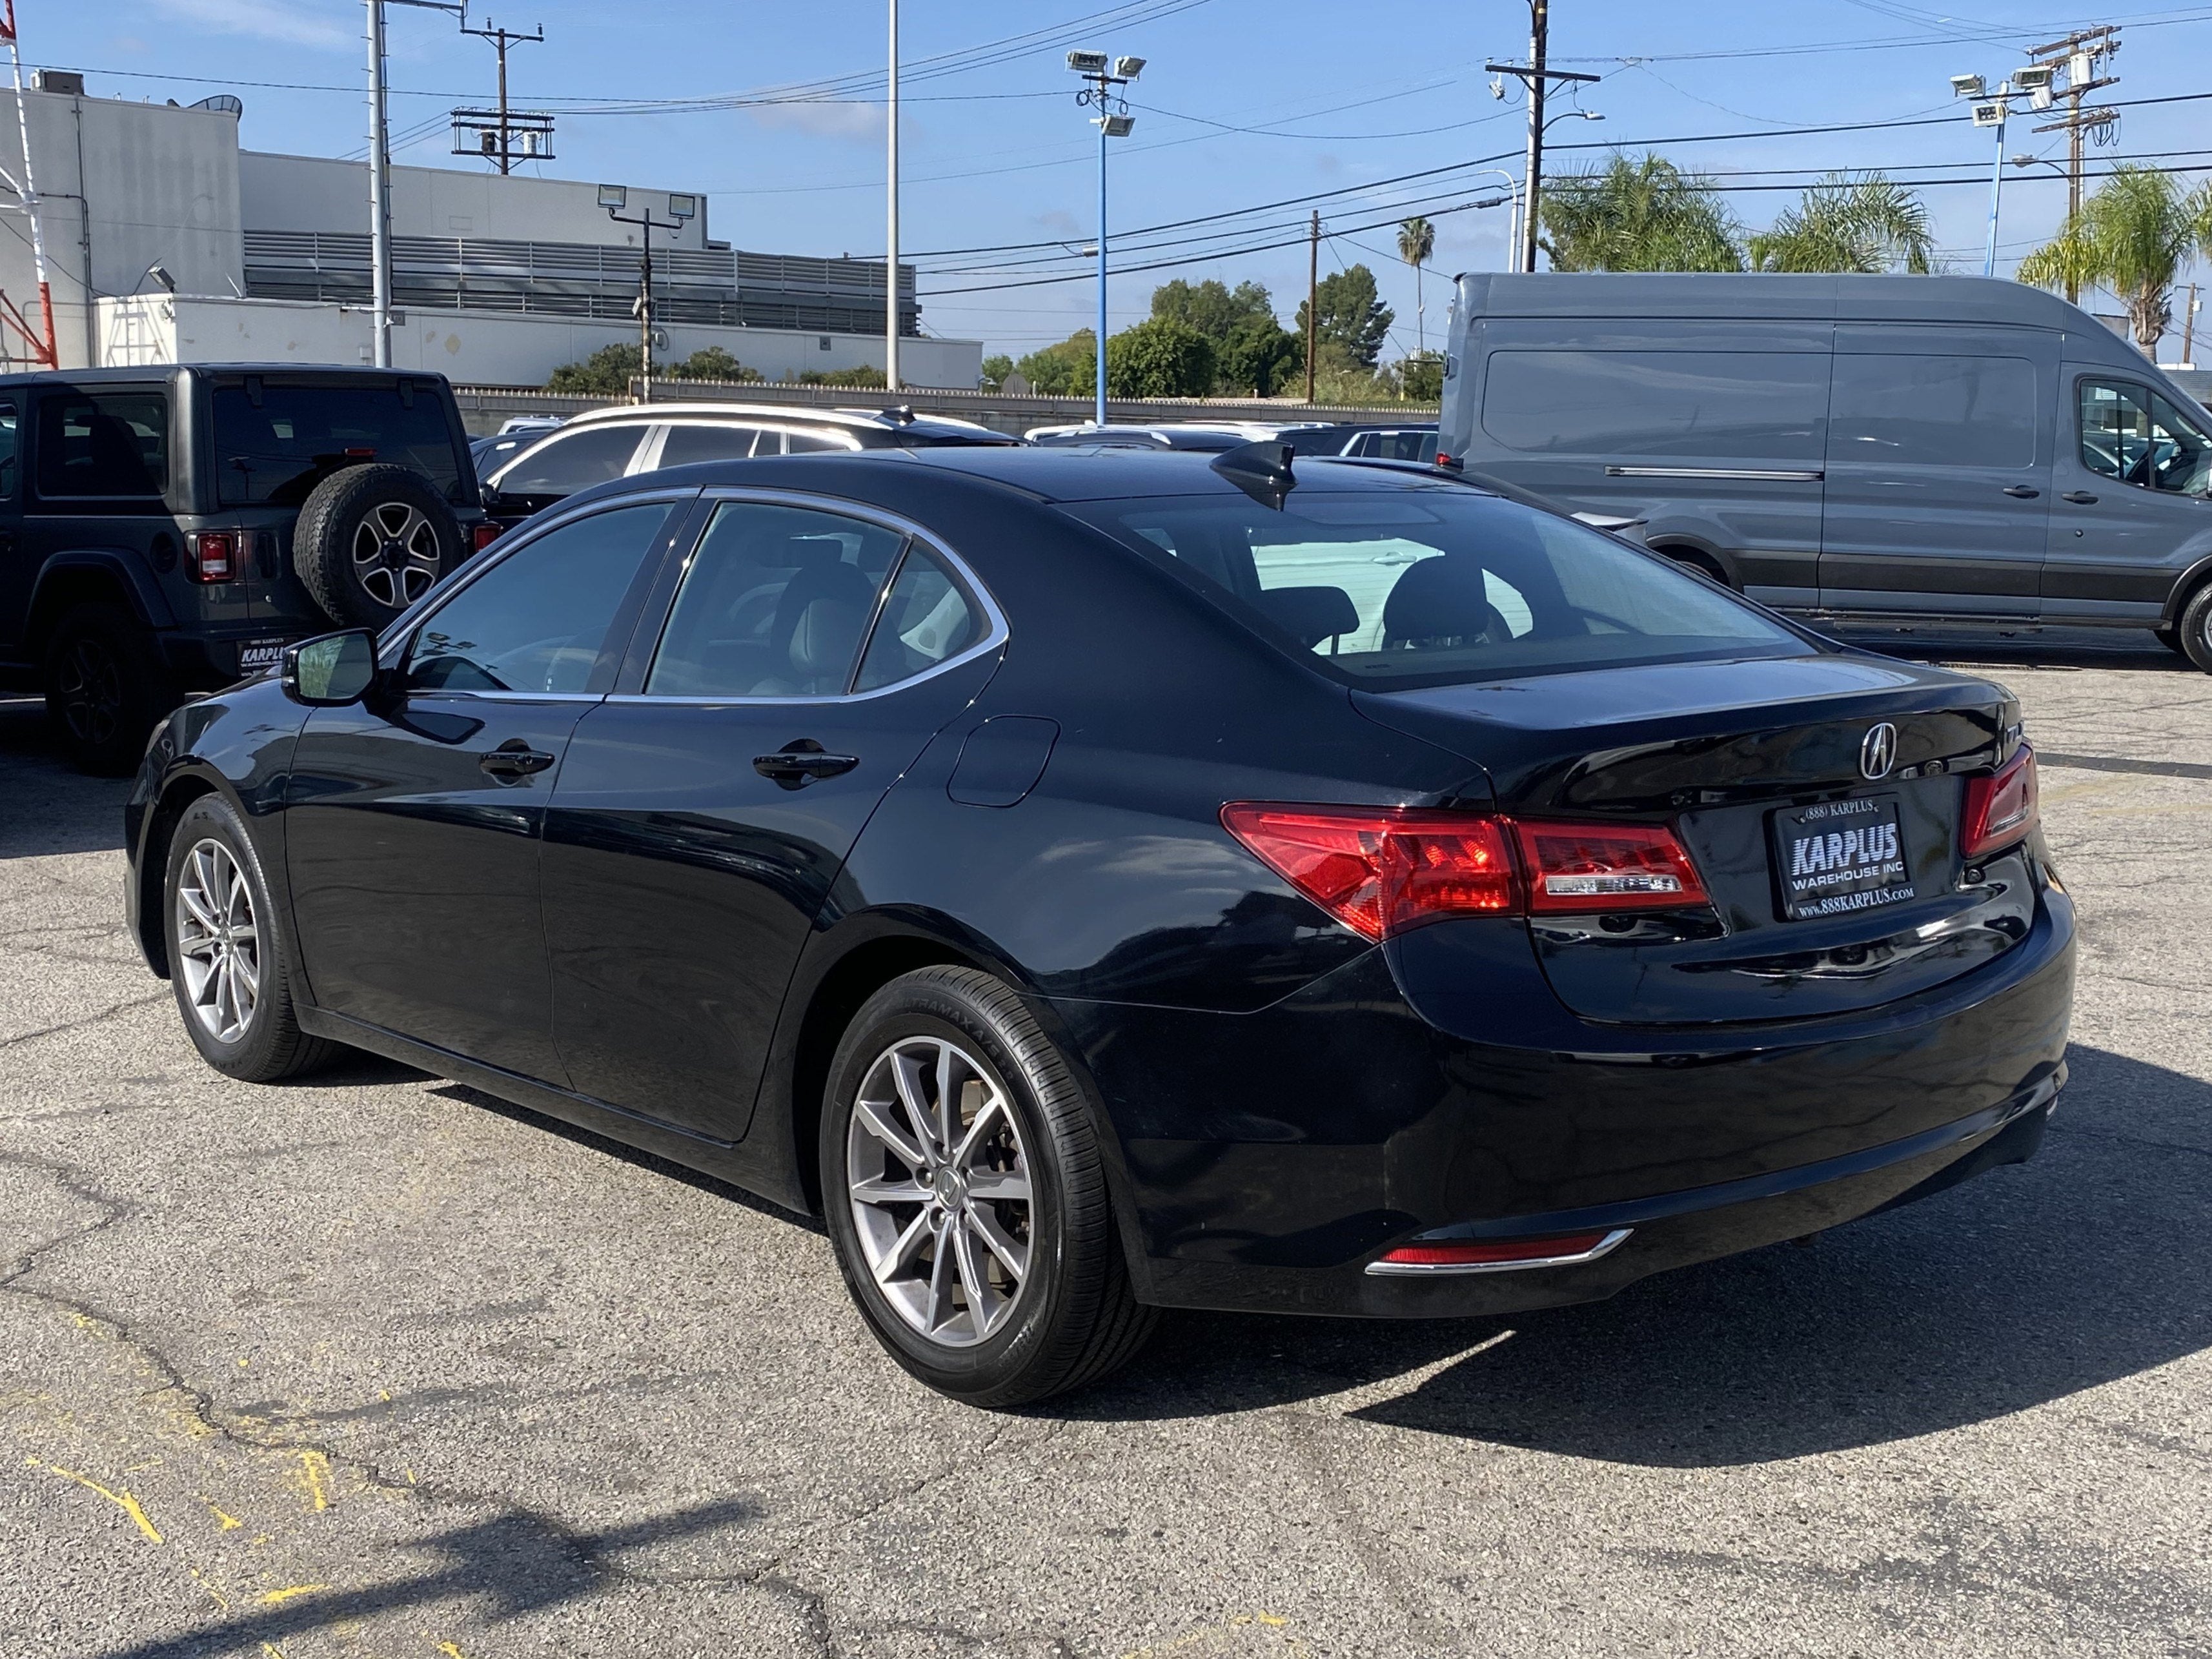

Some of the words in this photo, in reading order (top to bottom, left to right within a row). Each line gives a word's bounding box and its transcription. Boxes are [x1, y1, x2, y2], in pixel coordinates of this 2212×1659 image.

[241, 647, 283, 662] KARPL
[1805, 805, 1828, 820] (888)
[1830, 799, 1873, 816] KARPLUS
[1791, 822, 1898, 876] KARPLUS
[1792, 865, 1880, 891] WAREHOUSE
[1883, 861, 1903, 874] INC
